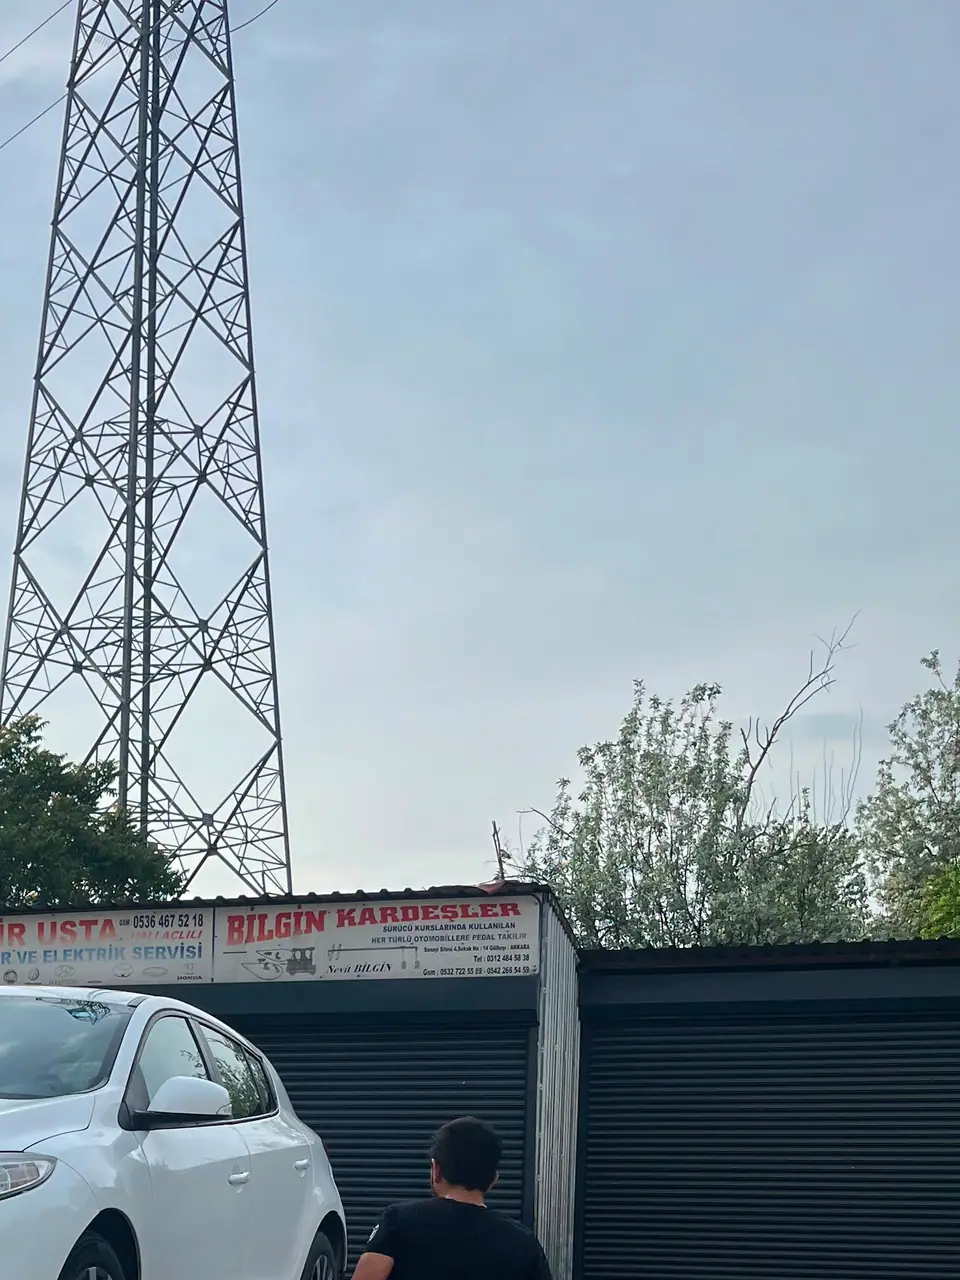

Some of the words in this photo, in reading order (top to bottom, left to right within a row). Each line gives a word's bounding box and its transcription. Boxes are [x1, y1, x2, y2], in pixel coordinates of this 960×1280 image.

[133, 915, 156, 928] 0536
[158, 914, 175, 928] 467
[178, 913, 190, 927] 52
[192, 913, 204, 927] 18
[226, 904, 327, 946] BİLGİN
[336, 902, 521, 928] KARDEŞLER
[382, 924, 413, 933] SÜRÜCÜ
[414, 923, 466, 932] KURSLARINDA
[468, 922, 516, 930] KULLANILAN
[37, 918, 118, 945] USTA
[371, 936, 386, 944] HER
[16, 950, 38, 964] VE
[43, 944, 126, 964] ELEKTRİK
[132, 942, 203, 961] SERVİSİ
[487, 954, 501, 962] 0312
